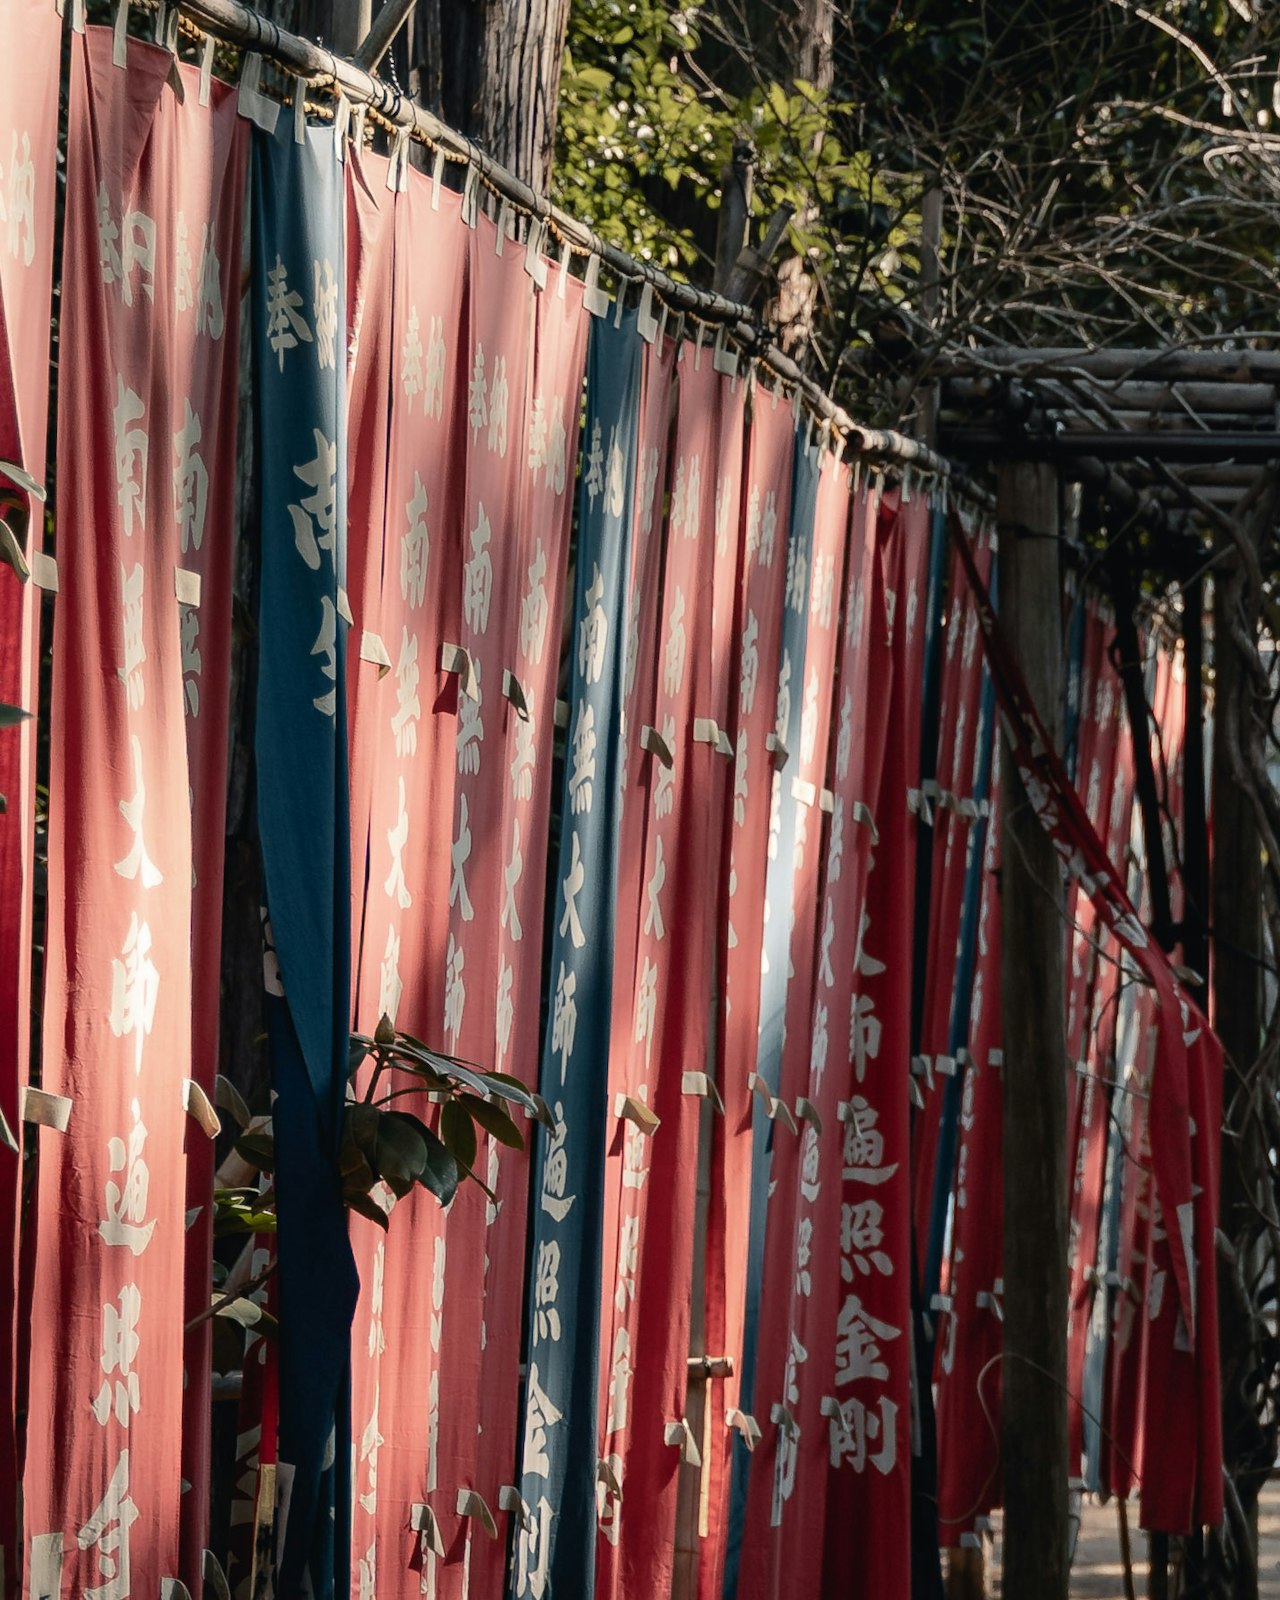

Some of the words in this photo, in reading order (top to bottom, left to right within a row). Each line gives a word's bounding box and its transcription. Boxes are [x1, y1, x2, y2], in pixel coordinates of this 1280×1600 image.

[401, 315, 446, 424] 奉納
[469, 342, 510, 459] 奉納
[528, 396, 566, 496] 奉納
[585, 417, 623, 517] 奉納
